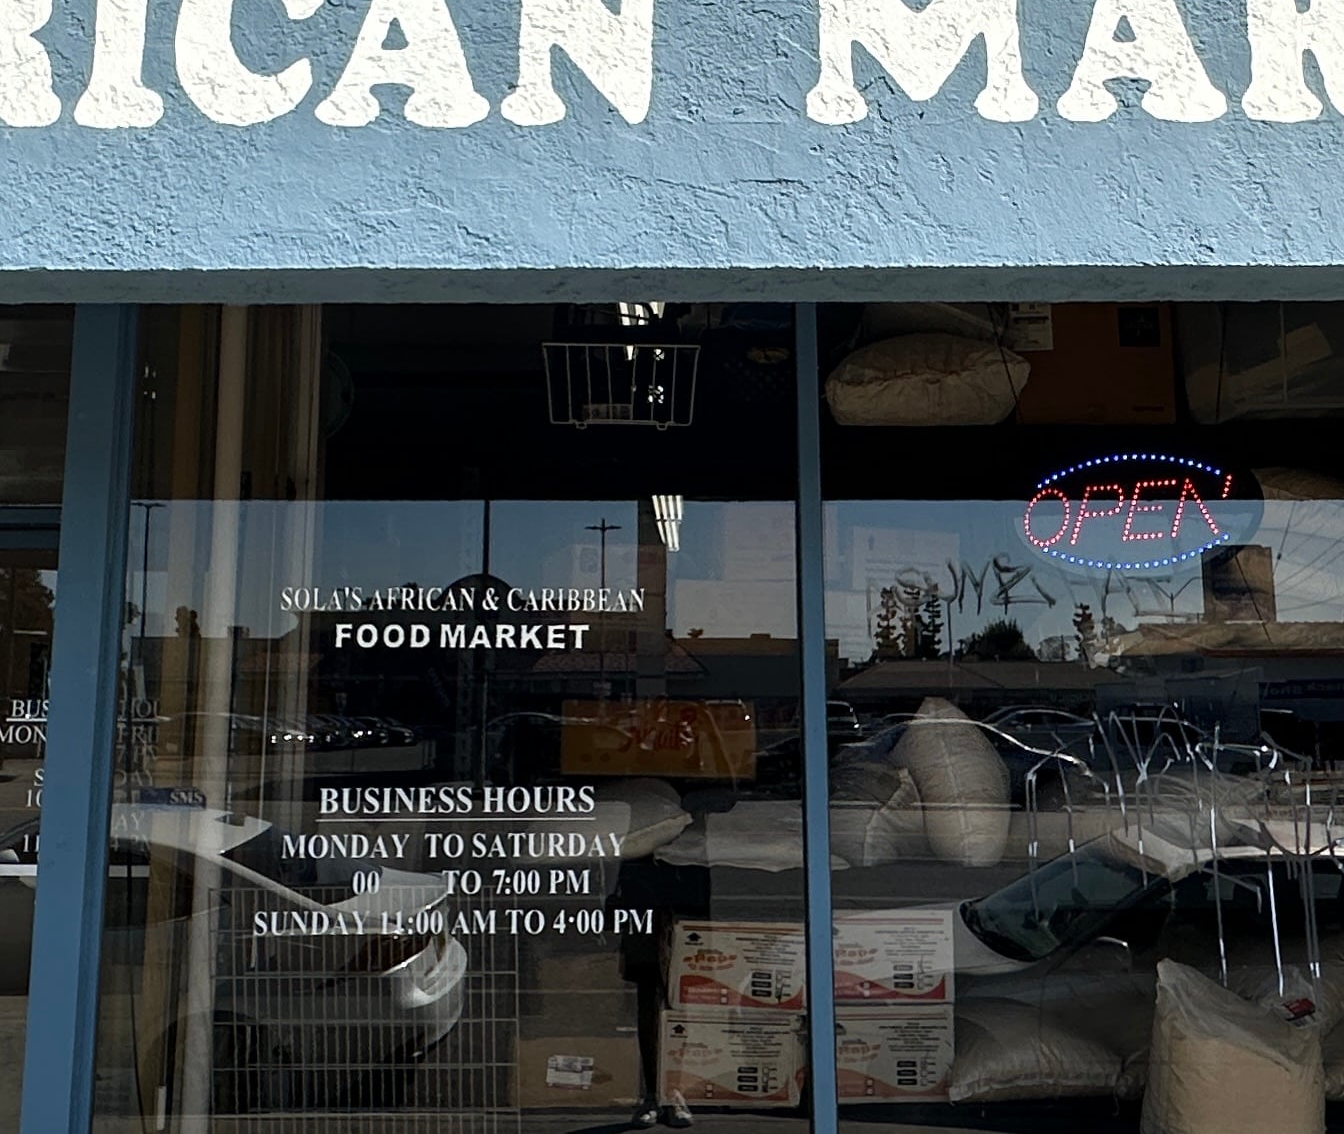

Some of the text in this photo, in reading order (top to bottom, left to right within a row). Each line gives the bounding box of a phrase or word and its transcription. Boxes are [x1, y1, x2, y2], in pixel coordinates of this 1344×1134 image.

[1023, 472, 1233, 548] OPEN
[280, 587, 645, 612] SOLA'S AFRICAN & CARIBBEAN
[335, 623, 590, 650] FOOD MARKET
[319, 786, 595, 814] BUSINESS HOURS
[281, 832, 626, 859] MONDAY TO SATURDAY
[441, 870, 482, 895] TO
[493, 870, 540, 895] 7:00
[549, 869, 590, 894] PM
[253, 911, 370, 936] SUNDAY
[380, 911, 444, 935] 11:00
[451, 910, 496, 935] AM
[504, 910, 546, 935] TO
[614, 909, 653, 935] PM
